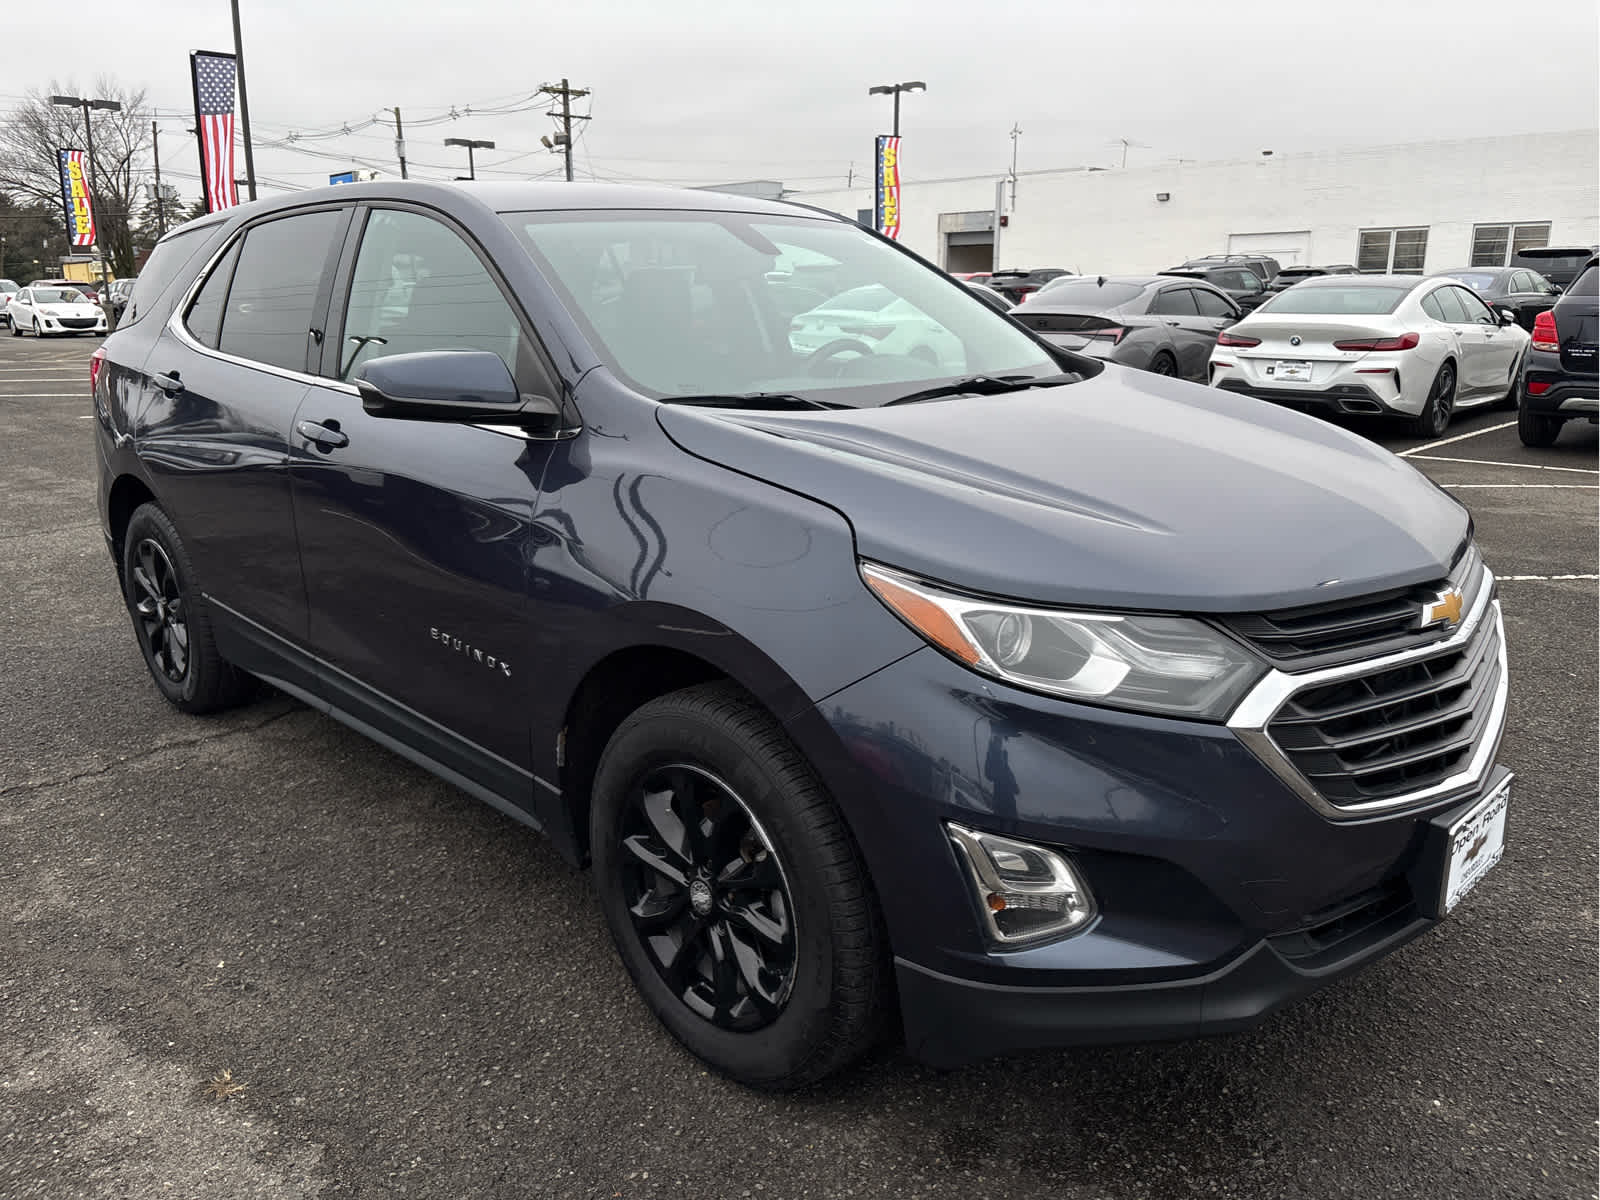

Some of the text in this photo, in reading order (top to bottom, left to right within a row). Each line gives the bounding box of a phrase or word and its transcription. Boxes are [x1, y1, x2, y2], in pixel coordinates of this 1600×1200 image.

[68, 161, 90, 234] SALE
[884, 148, 897, 227] SALE
[431, 627, 511, 677] EQUINOX
[1482, 794, 1508, 828] Road
